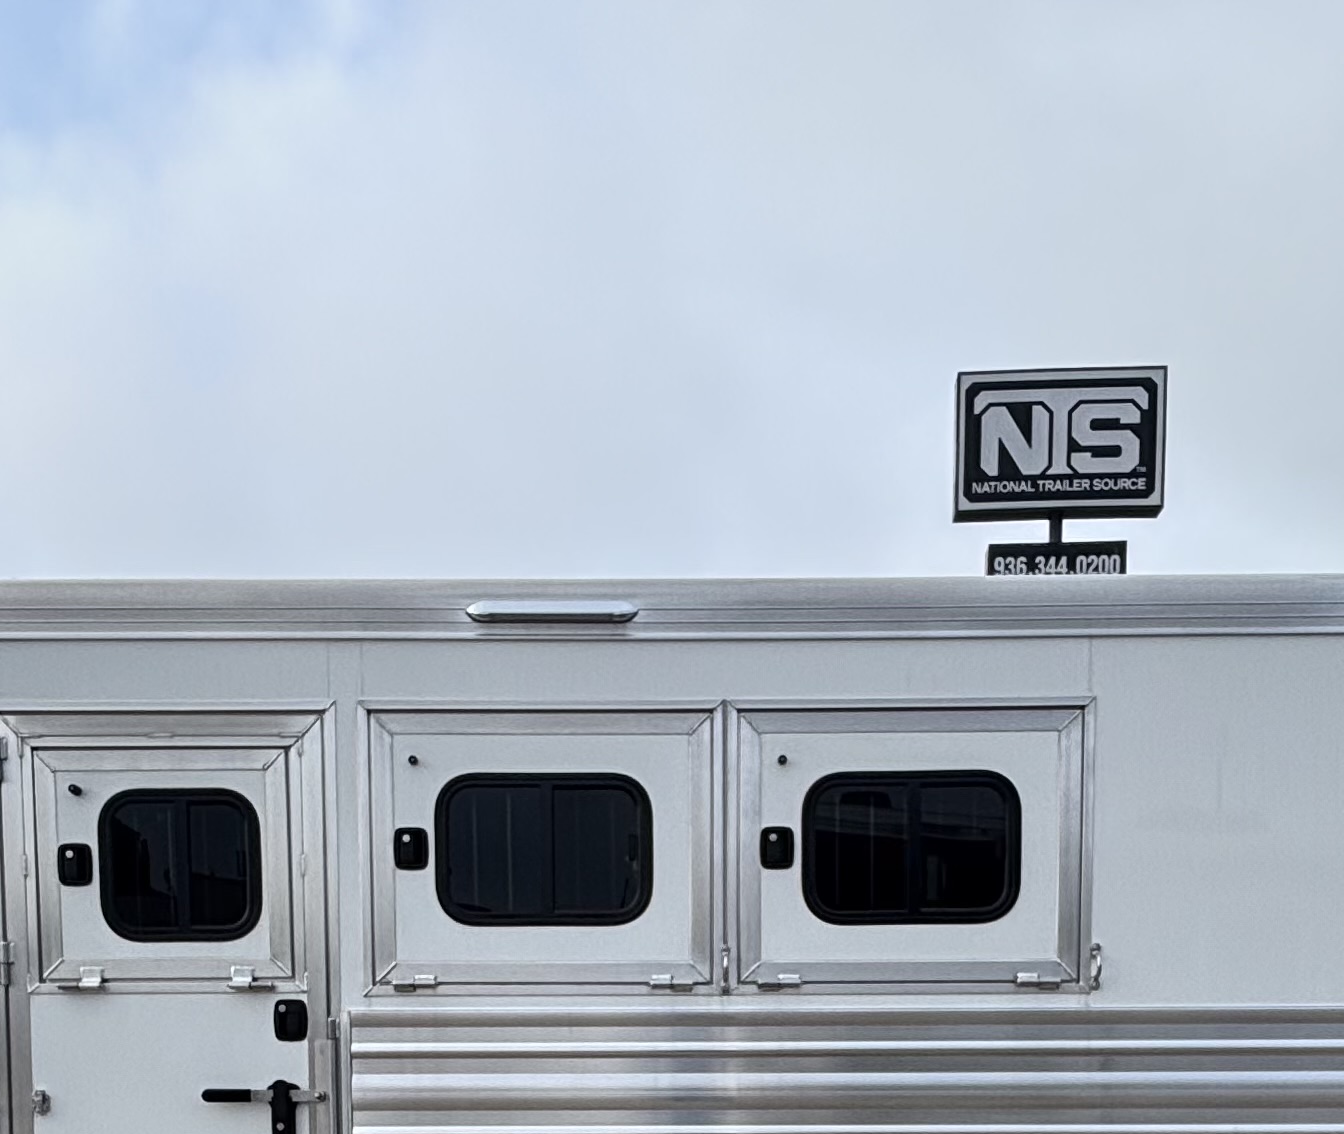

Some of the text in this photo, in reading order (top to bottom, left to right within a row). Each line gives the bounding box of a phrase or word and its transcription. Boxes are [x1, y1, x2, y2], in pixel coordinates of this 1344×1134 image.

[974, 386, 1149, 477] NTS
[972, 477, 1147, 494] NATIONAL TRAILER SOURCE
[993, 554, 1121, 575] 936.344.0200
